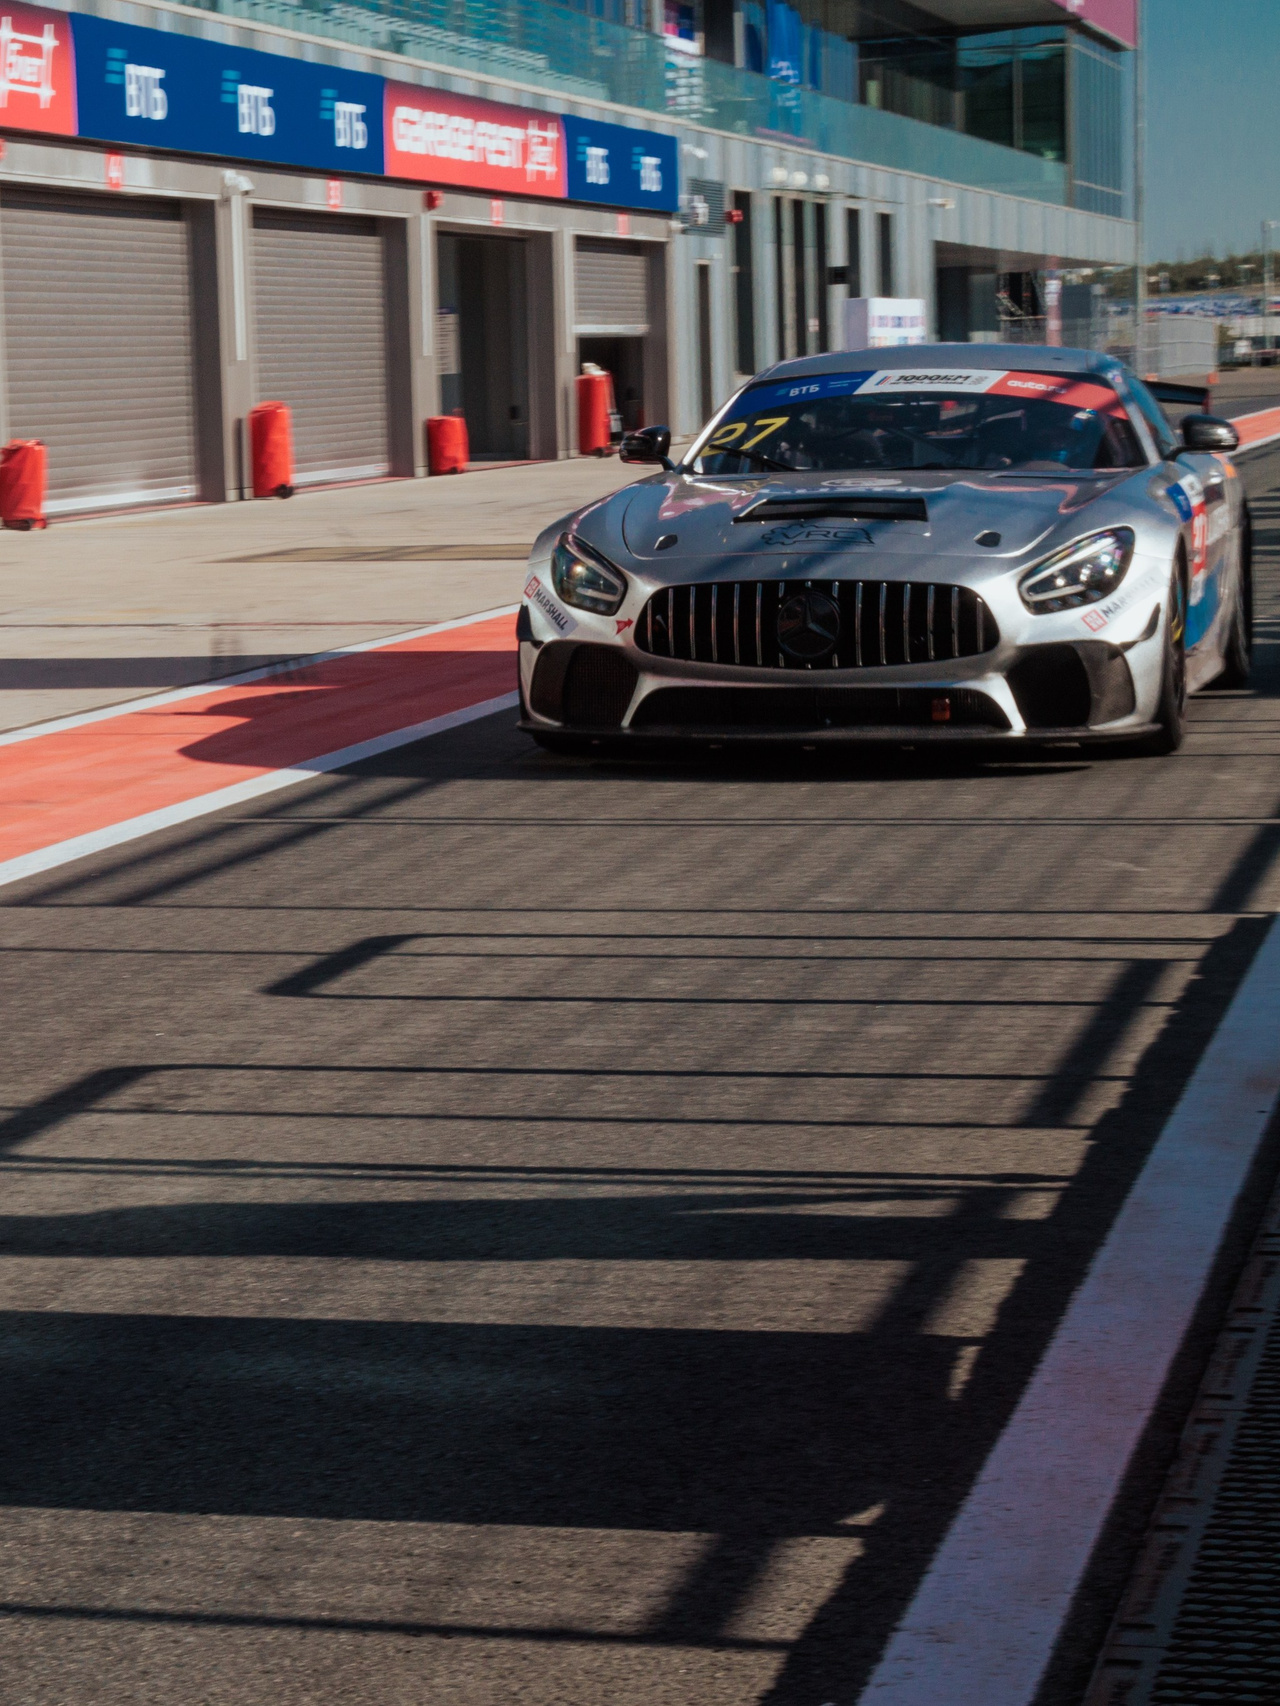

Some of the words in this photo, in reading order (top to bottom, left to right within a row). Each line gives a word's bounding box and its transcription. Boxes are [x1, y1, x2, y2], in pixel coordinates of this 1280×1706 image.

[789, 384, 820, 397] ВТБ
[700, 416, 790, 458] 27
[780, 530, 858, 540] VRC
[533, 589, 569, 631] MARSHALL
